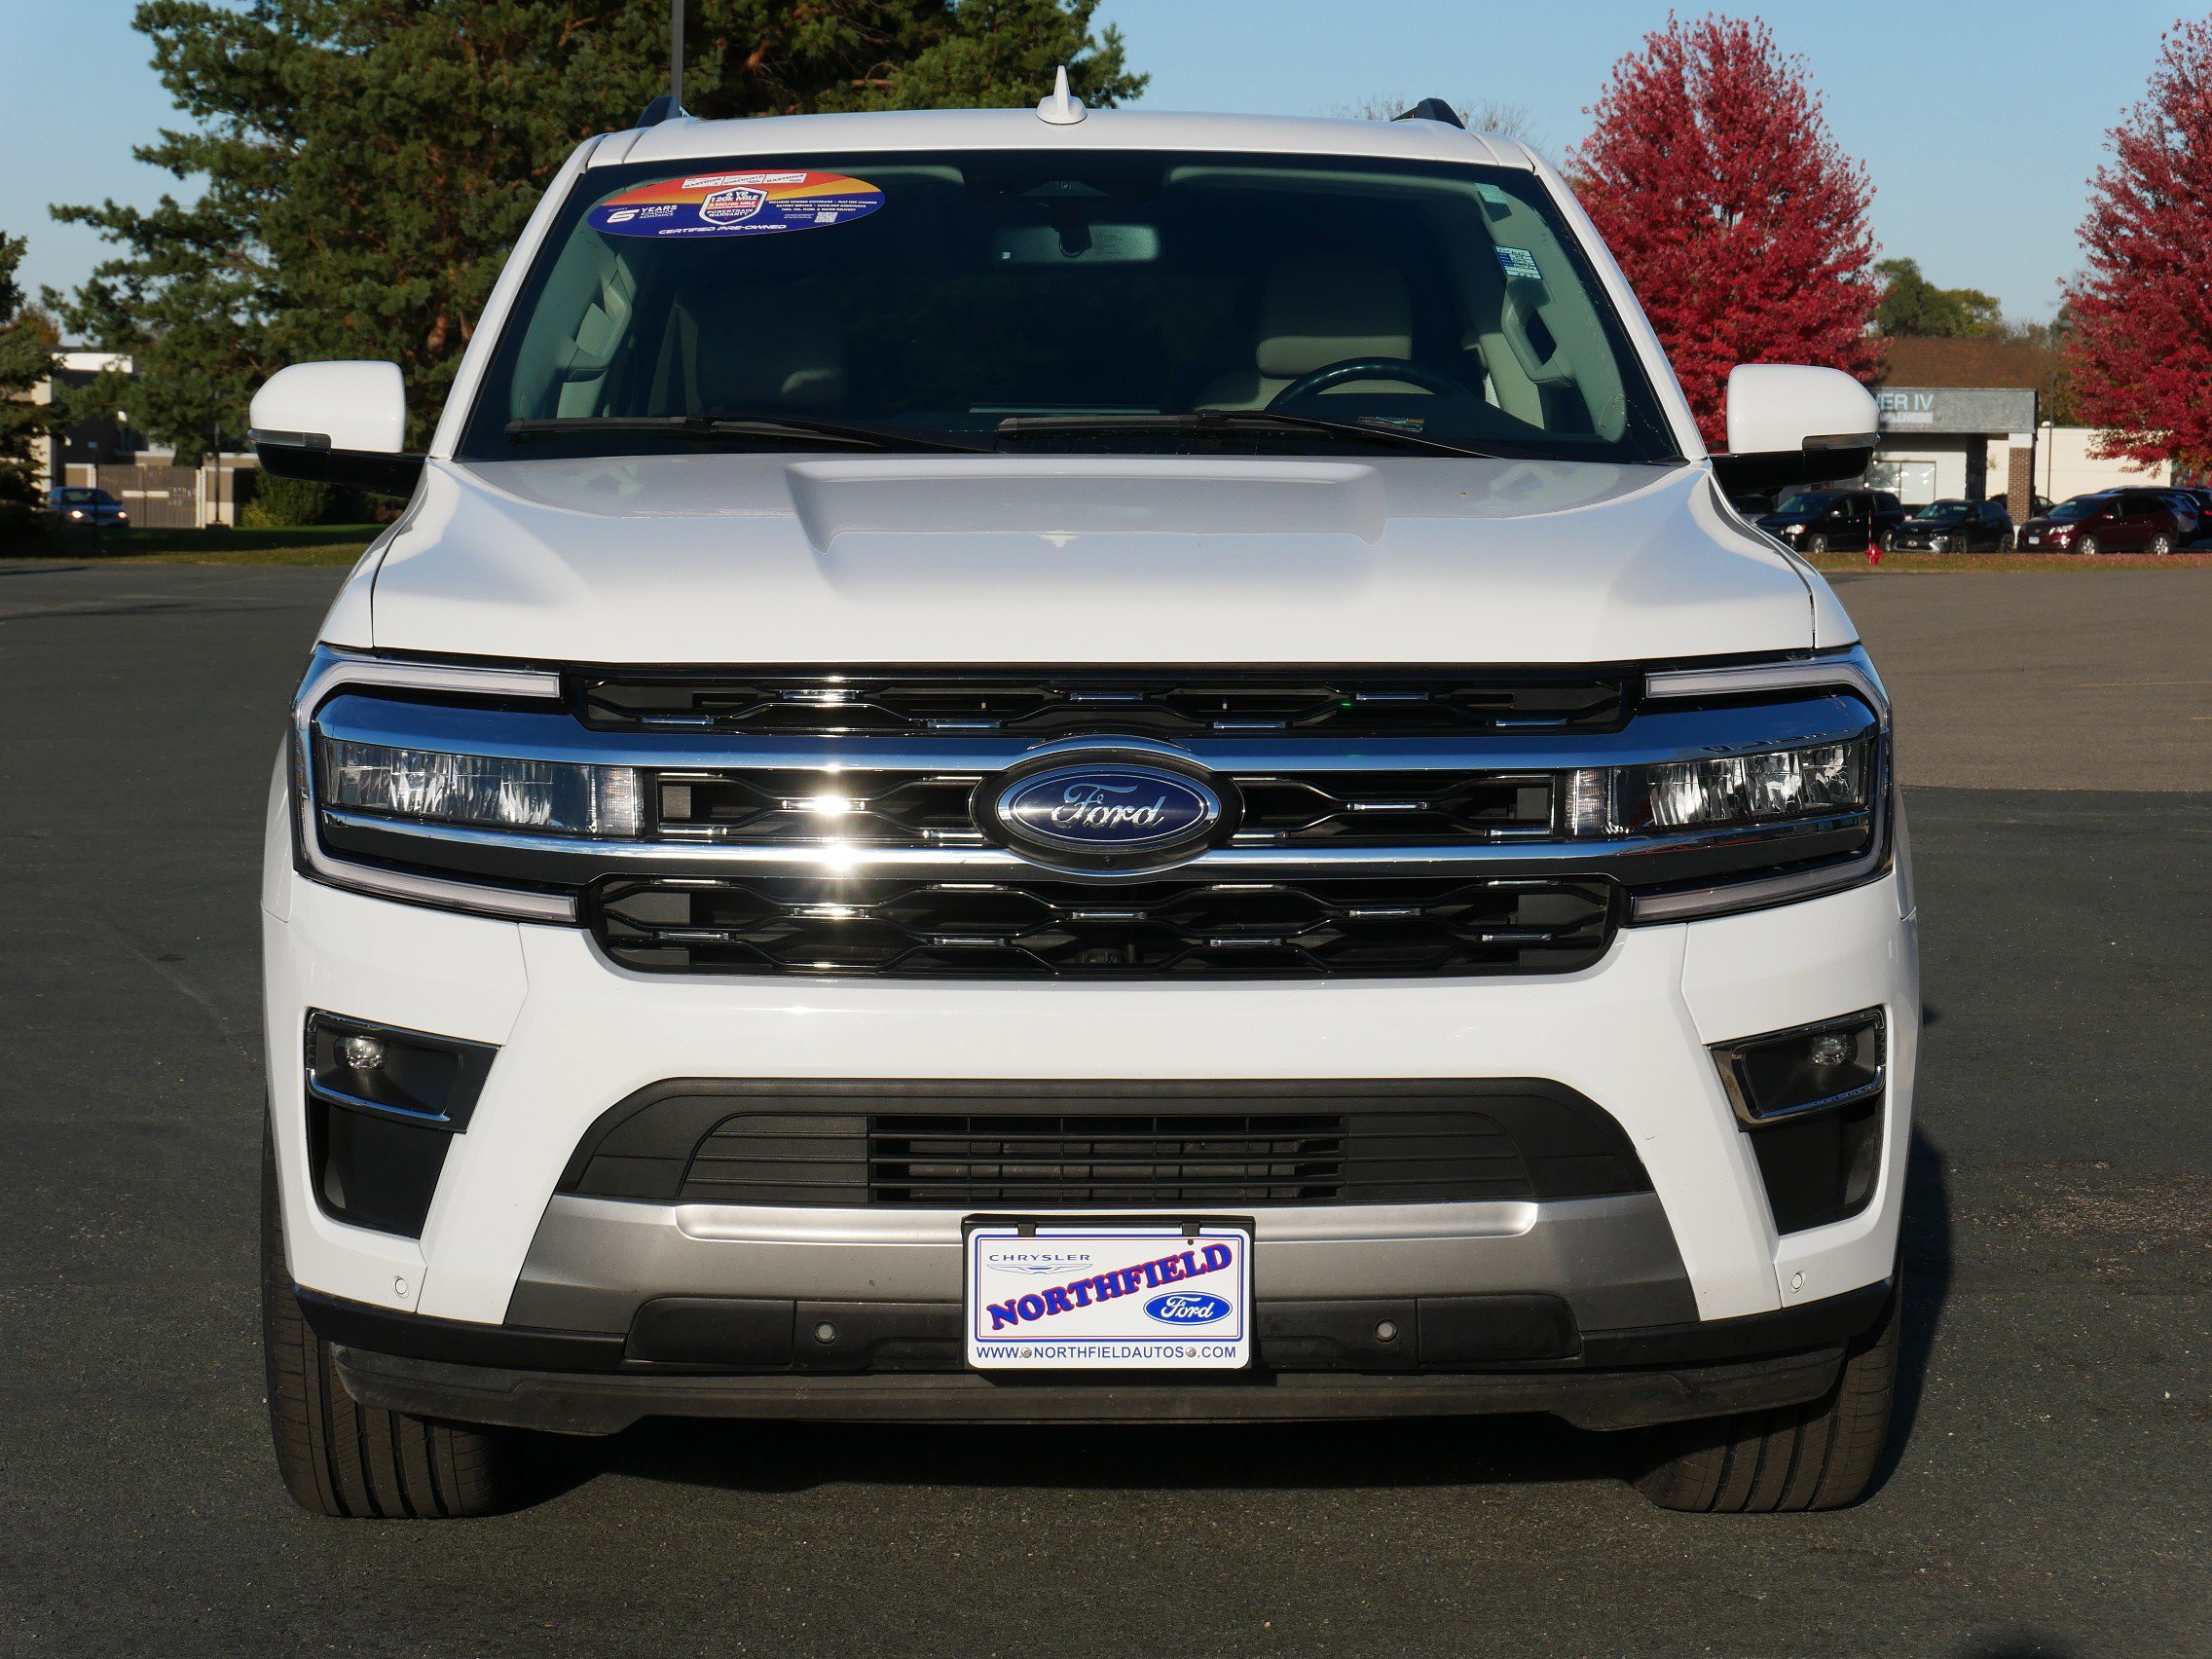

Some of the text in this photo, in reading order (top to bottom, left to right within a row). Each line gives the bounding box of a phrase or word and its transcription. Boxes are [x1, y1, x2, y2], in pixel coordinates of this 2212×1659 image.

[1914, 393, 1934, 411] IV
[1051, 783, 1167, 830] Ford
[986, 1243, 1233, 1331] NORTHFIELD
[1161, 1296, 1214, 1318] Ford
